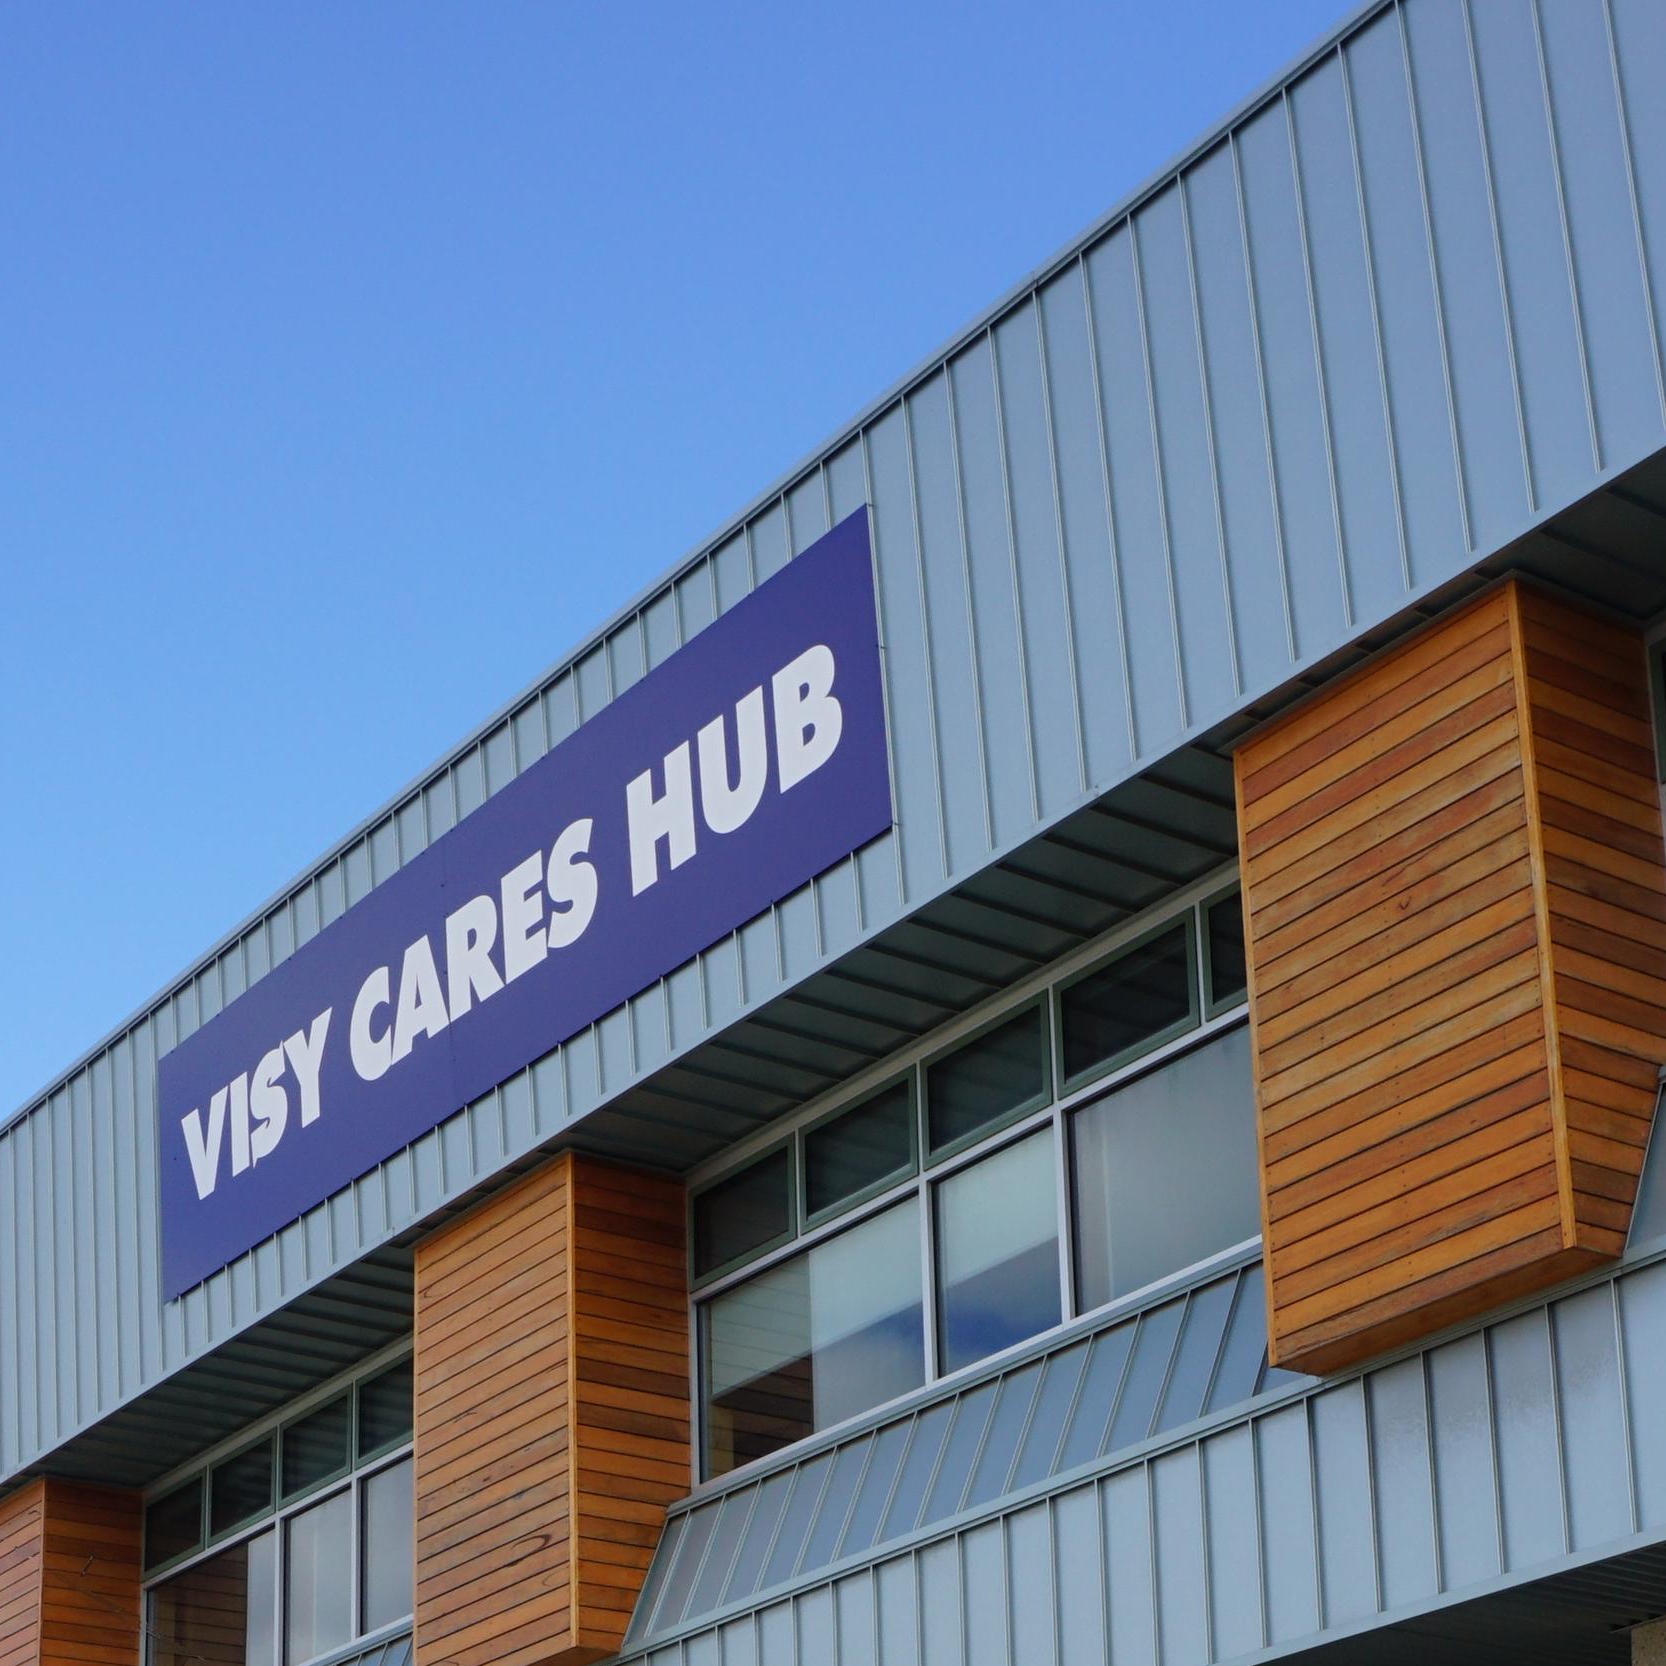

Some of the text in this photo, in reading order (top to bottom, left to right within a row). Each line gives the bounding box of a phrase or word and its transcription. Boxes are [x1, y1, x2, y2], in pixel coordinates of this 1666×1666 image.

[181, 644, 843, 1200] VISY CARES HUB
